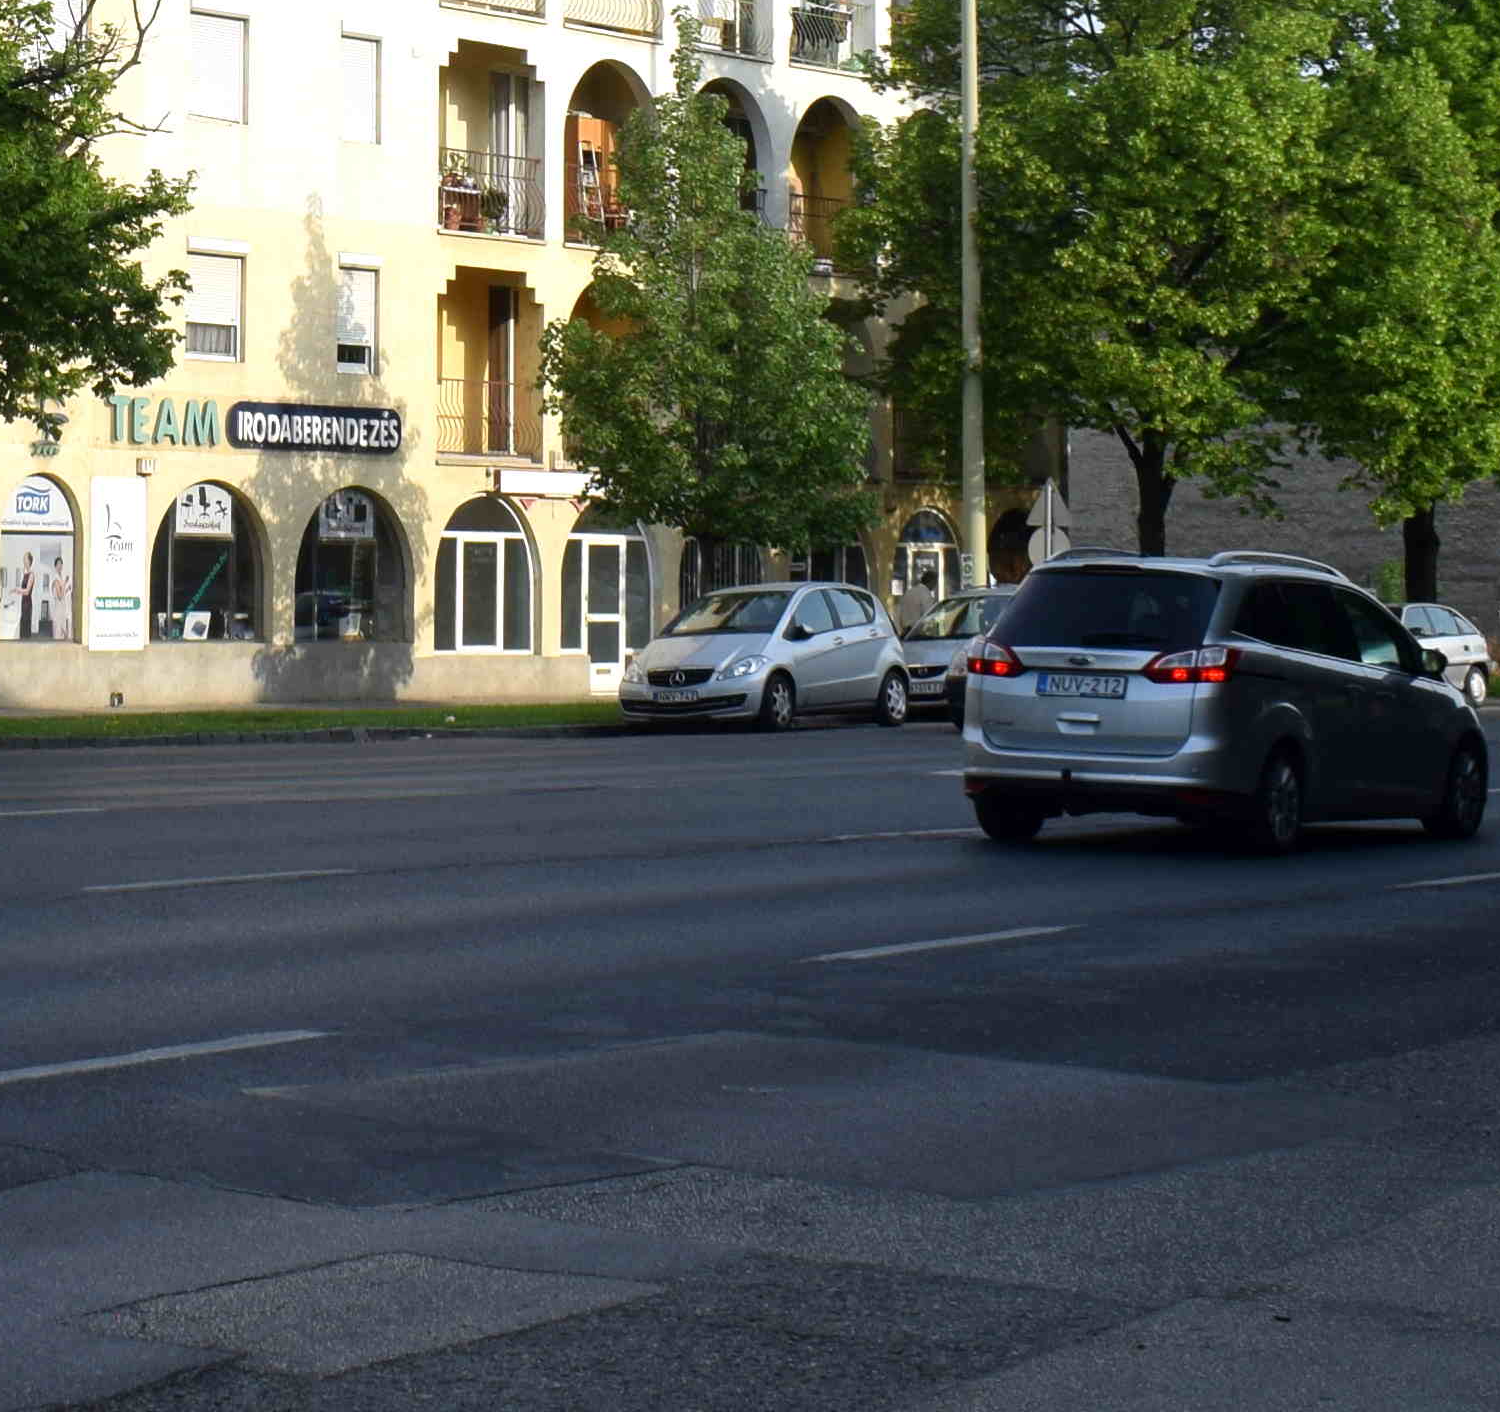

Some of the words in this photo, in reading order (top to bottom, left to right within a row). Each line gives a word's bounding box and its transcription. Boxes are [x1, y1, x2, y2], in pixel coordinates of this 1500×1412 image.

[106, 395, 221, 448] TEAM
[238, 410, 399, 448] IRODABERENDEZÉS
[18, 496, 48, 512] TORK
[1051, 676, 1122, 695] NUV-212
